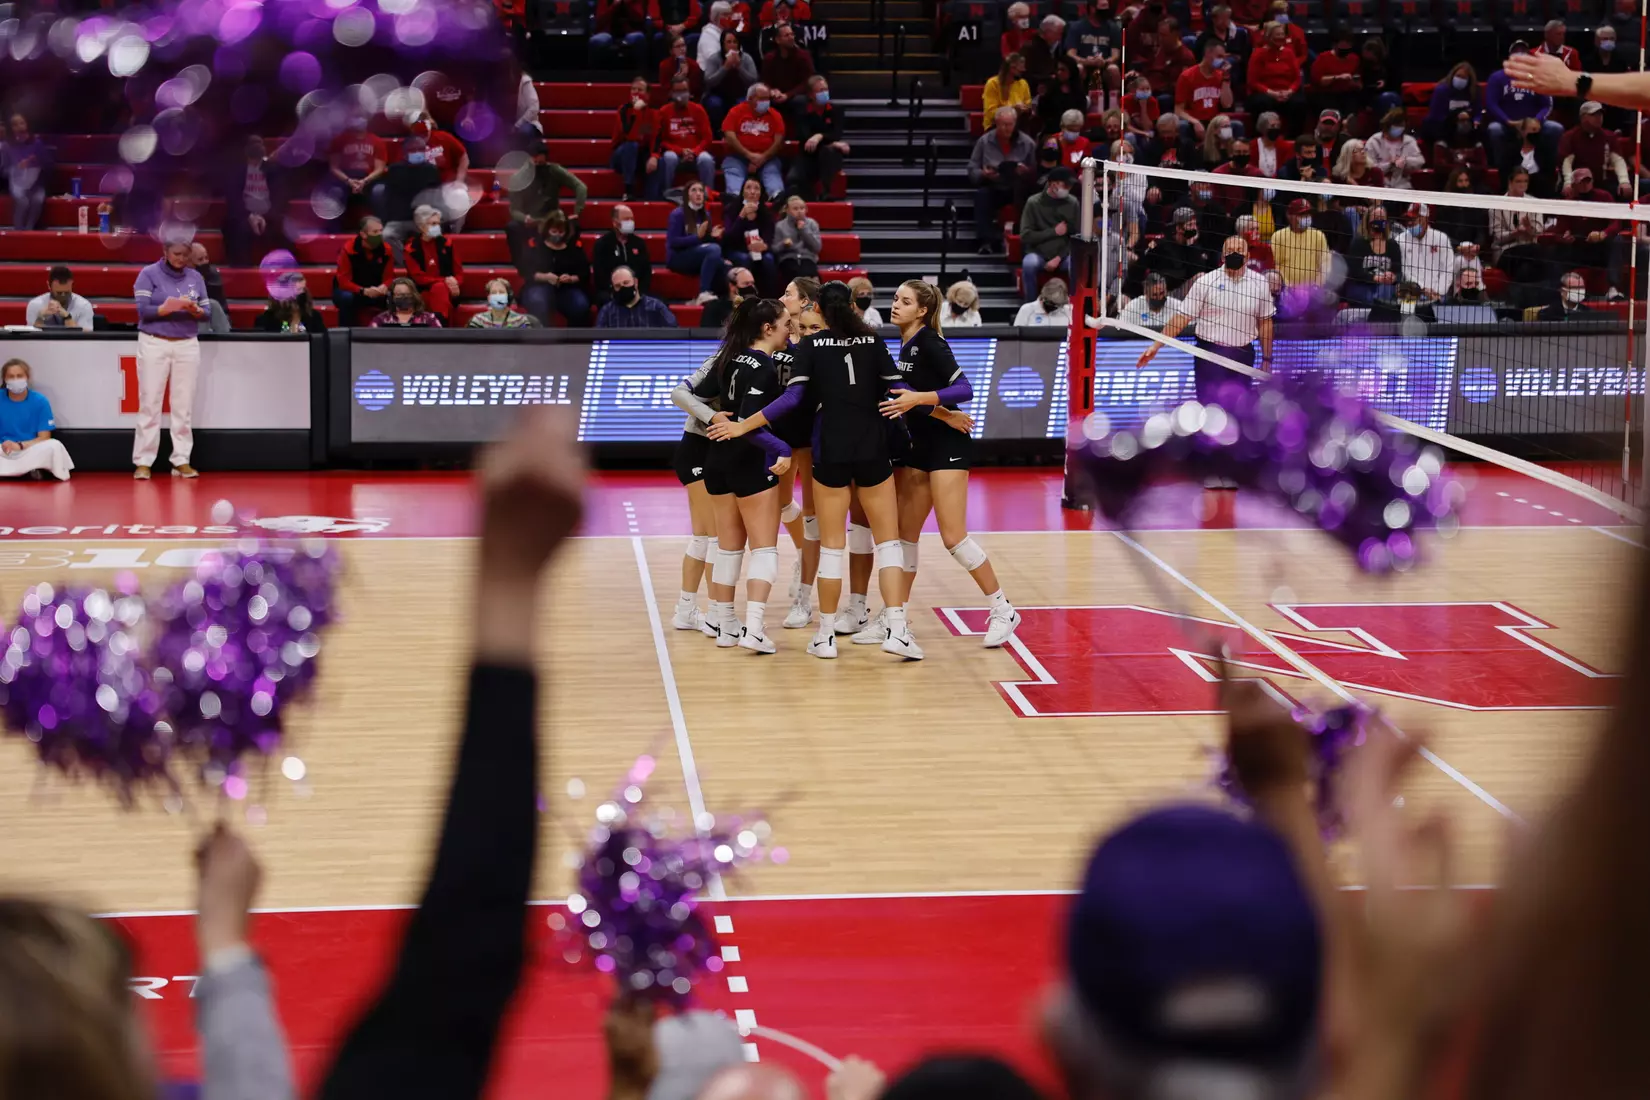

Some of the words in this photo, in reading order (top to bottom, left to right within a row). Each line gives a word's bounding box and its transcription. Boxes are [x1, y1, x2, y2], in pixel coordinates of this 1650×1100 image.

[803, 26, 827, 44] A14
[958, 26, 977, 40] A1
[813, 336, 875, 347] WILDCATS
[844, 352, 856, 385] 1
[402, 375, 572, 405] VOLLEYBALL
